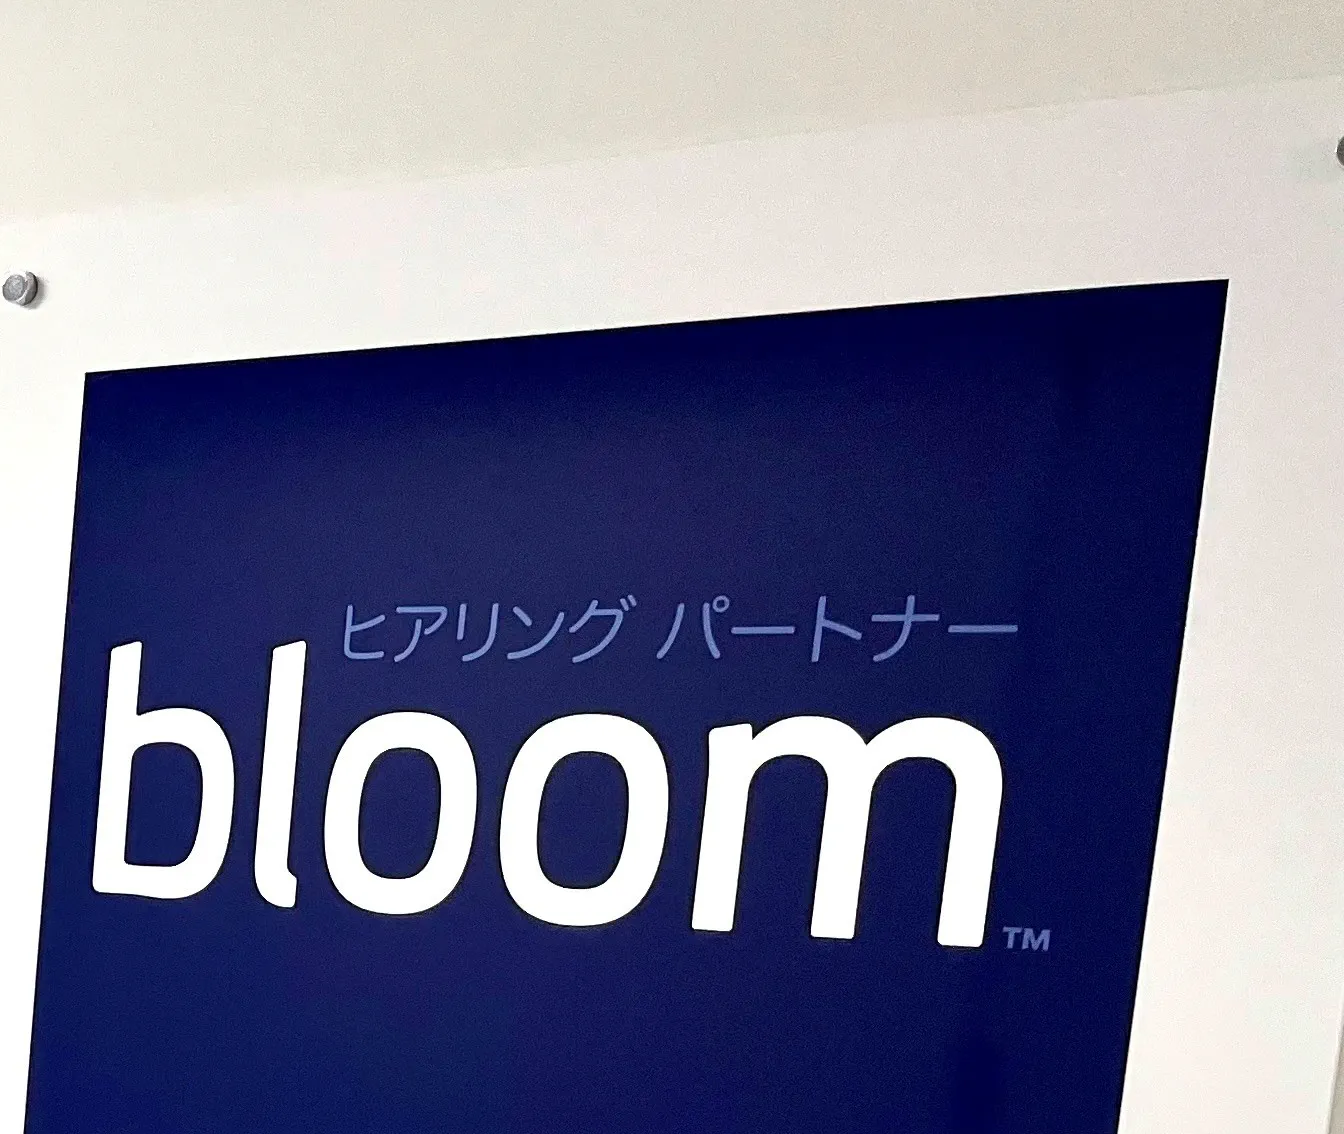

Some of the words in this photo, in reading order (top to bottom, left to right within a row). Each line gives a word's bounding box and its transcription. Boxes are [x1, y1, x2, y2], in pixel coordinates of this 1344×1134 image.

[343, 597, 637, 662] ヒアリング
[657, 595, 1018, 663] パートナー
[92, 640, 1004, 949] bloom
